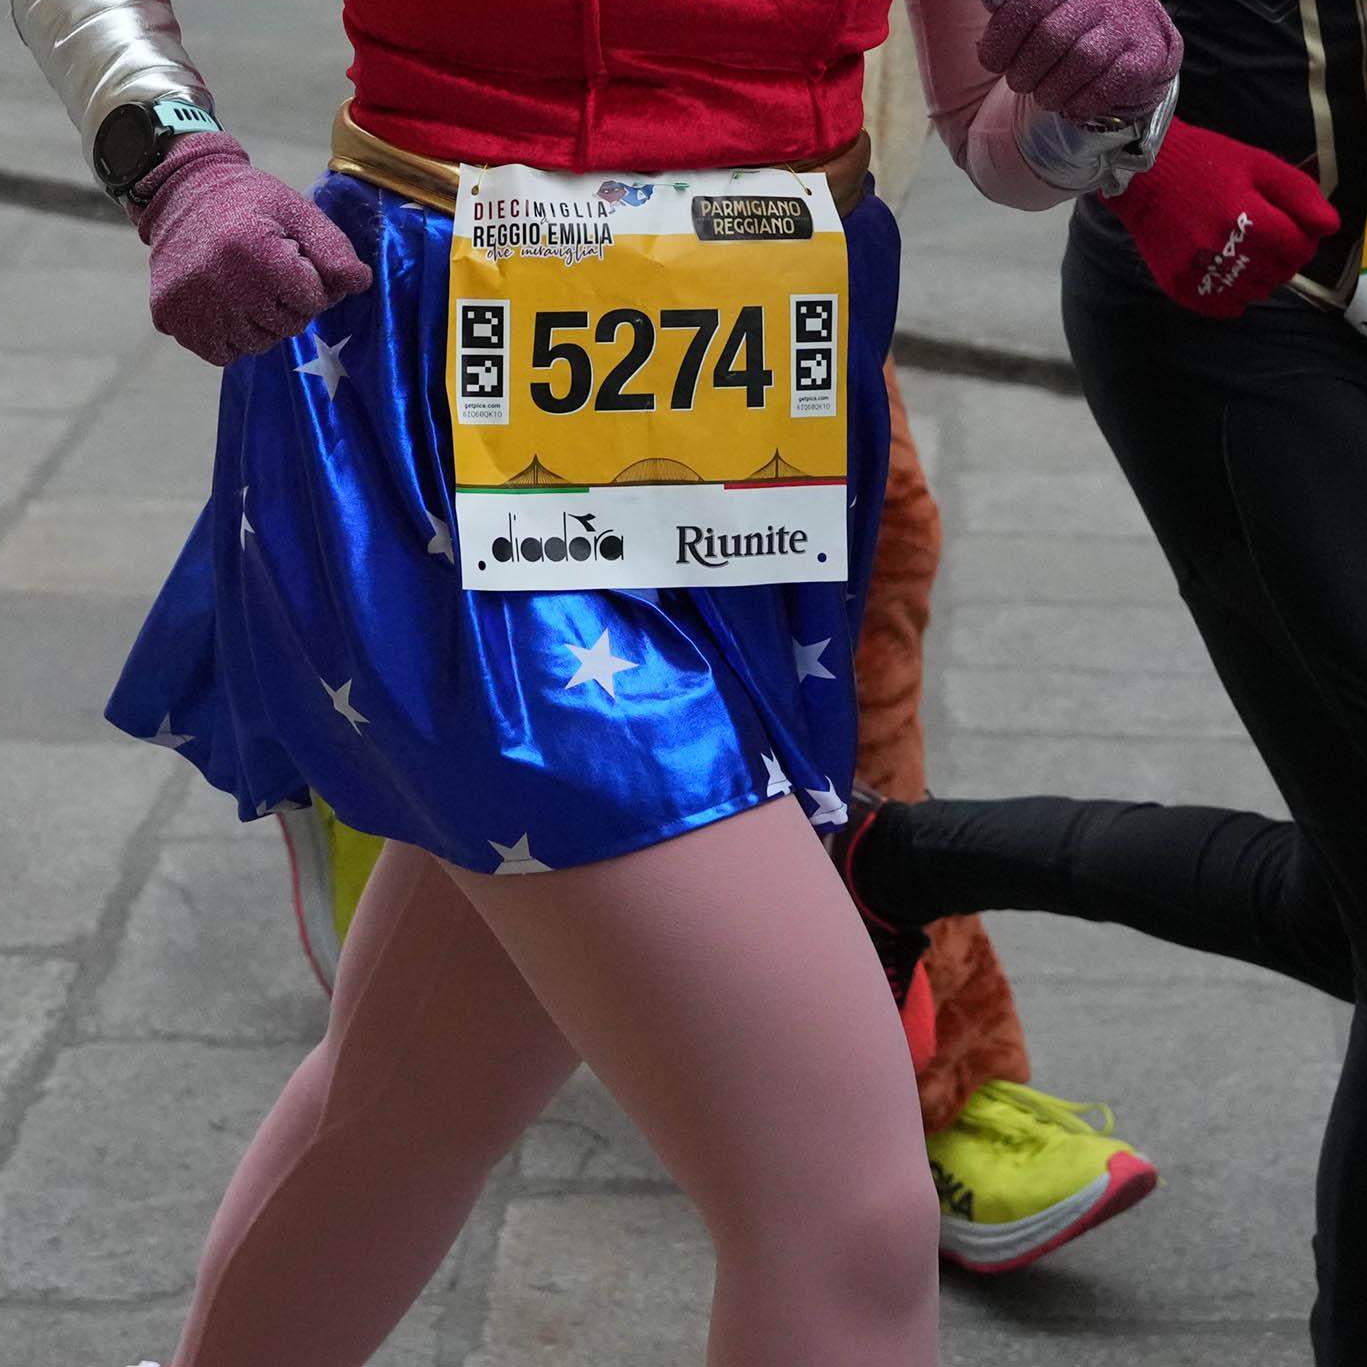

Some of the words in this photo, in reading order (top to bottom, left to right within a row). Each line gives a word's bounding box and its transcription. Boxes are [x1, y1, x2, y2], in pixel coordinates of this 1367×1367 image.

[700, 199, 802, 217] PARMIGIANO
[473, 222, 541, 248] REGGIO
[548, 222, 613, 245] EMILIA
[712, 217, 796, 235] REGGIANO
[529, 305, 774, 415] 5274
[491, 511, 625, 563] diadora
[675, 524, 809, 568] Riunite
